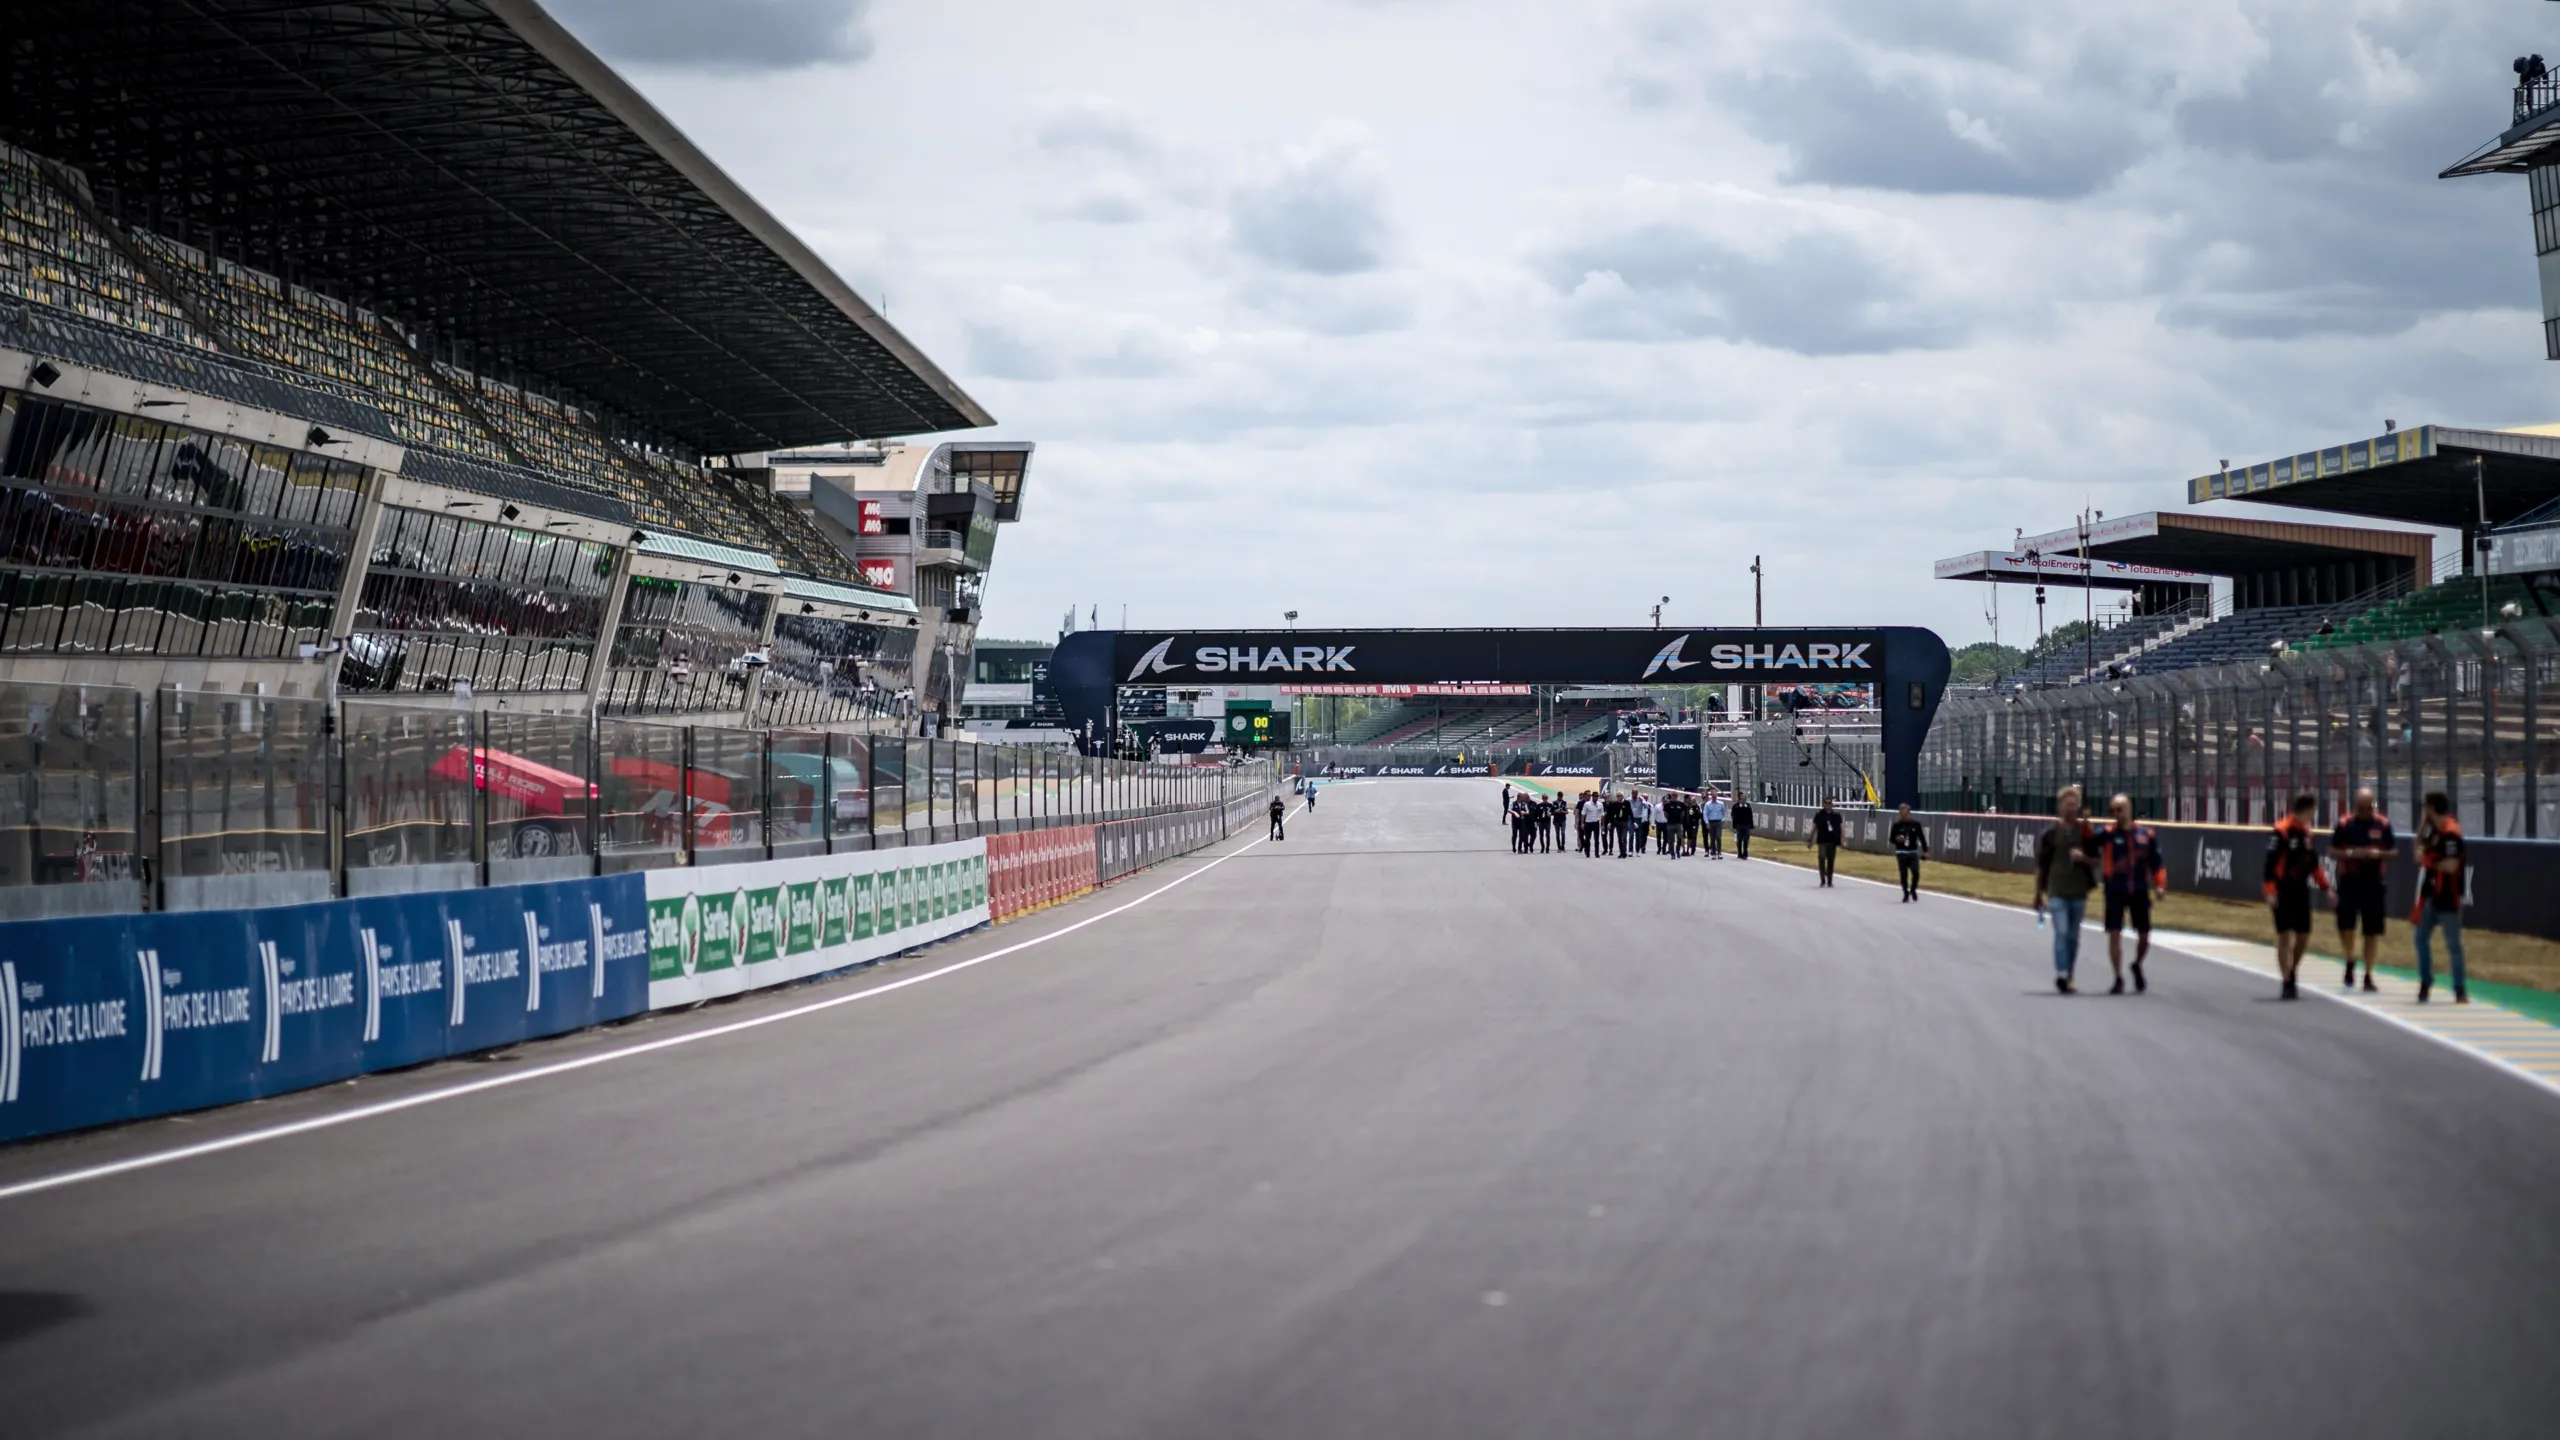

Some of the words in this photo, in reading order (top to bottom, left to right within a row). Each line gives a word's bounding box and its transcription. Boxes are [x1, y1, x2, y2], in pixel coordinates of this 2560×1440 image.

[1196, 646, 1356, 671] SHARK
[1711, 643, 1872, 669] SHARK
[1164, 733, 1206, 741] SHARK
[1450, 766, 1489, 774] SHARK
[2205, 848, 2232, 881] SHARK
[703, 901, 729, 942] Sarthe
[751, 896, 774, 935] Sarthe
[791, 890, 812, 927] Sarthe
[650, 906, 679, 949] Sarthe
[280, 981, 303, 1014] PAYS
[304, 979, 316, 1012] DE
[317, 976, 329, 1009] LA
[329, 972, 354, 1006] LOIRE
[380, 966, 400, 997] PAYS
[400, 964, 410, 994] DE
[411, 963, 420, 992] LA
[420, 960, 442, 991] LOIRE
[22, 1009, 54, 1048] PAYS
[56, 1004, 73, 1044] DE
[75, 1002, 91, 1041] LA
[93, 998, 126, 1038] LOIRE
[163, 991, 190, 1030] PAYS
[192, 991, 205, 1027] DE
[207, 990, 221, 1025] LA
[222, 988, 250, 1024] LOIRE
